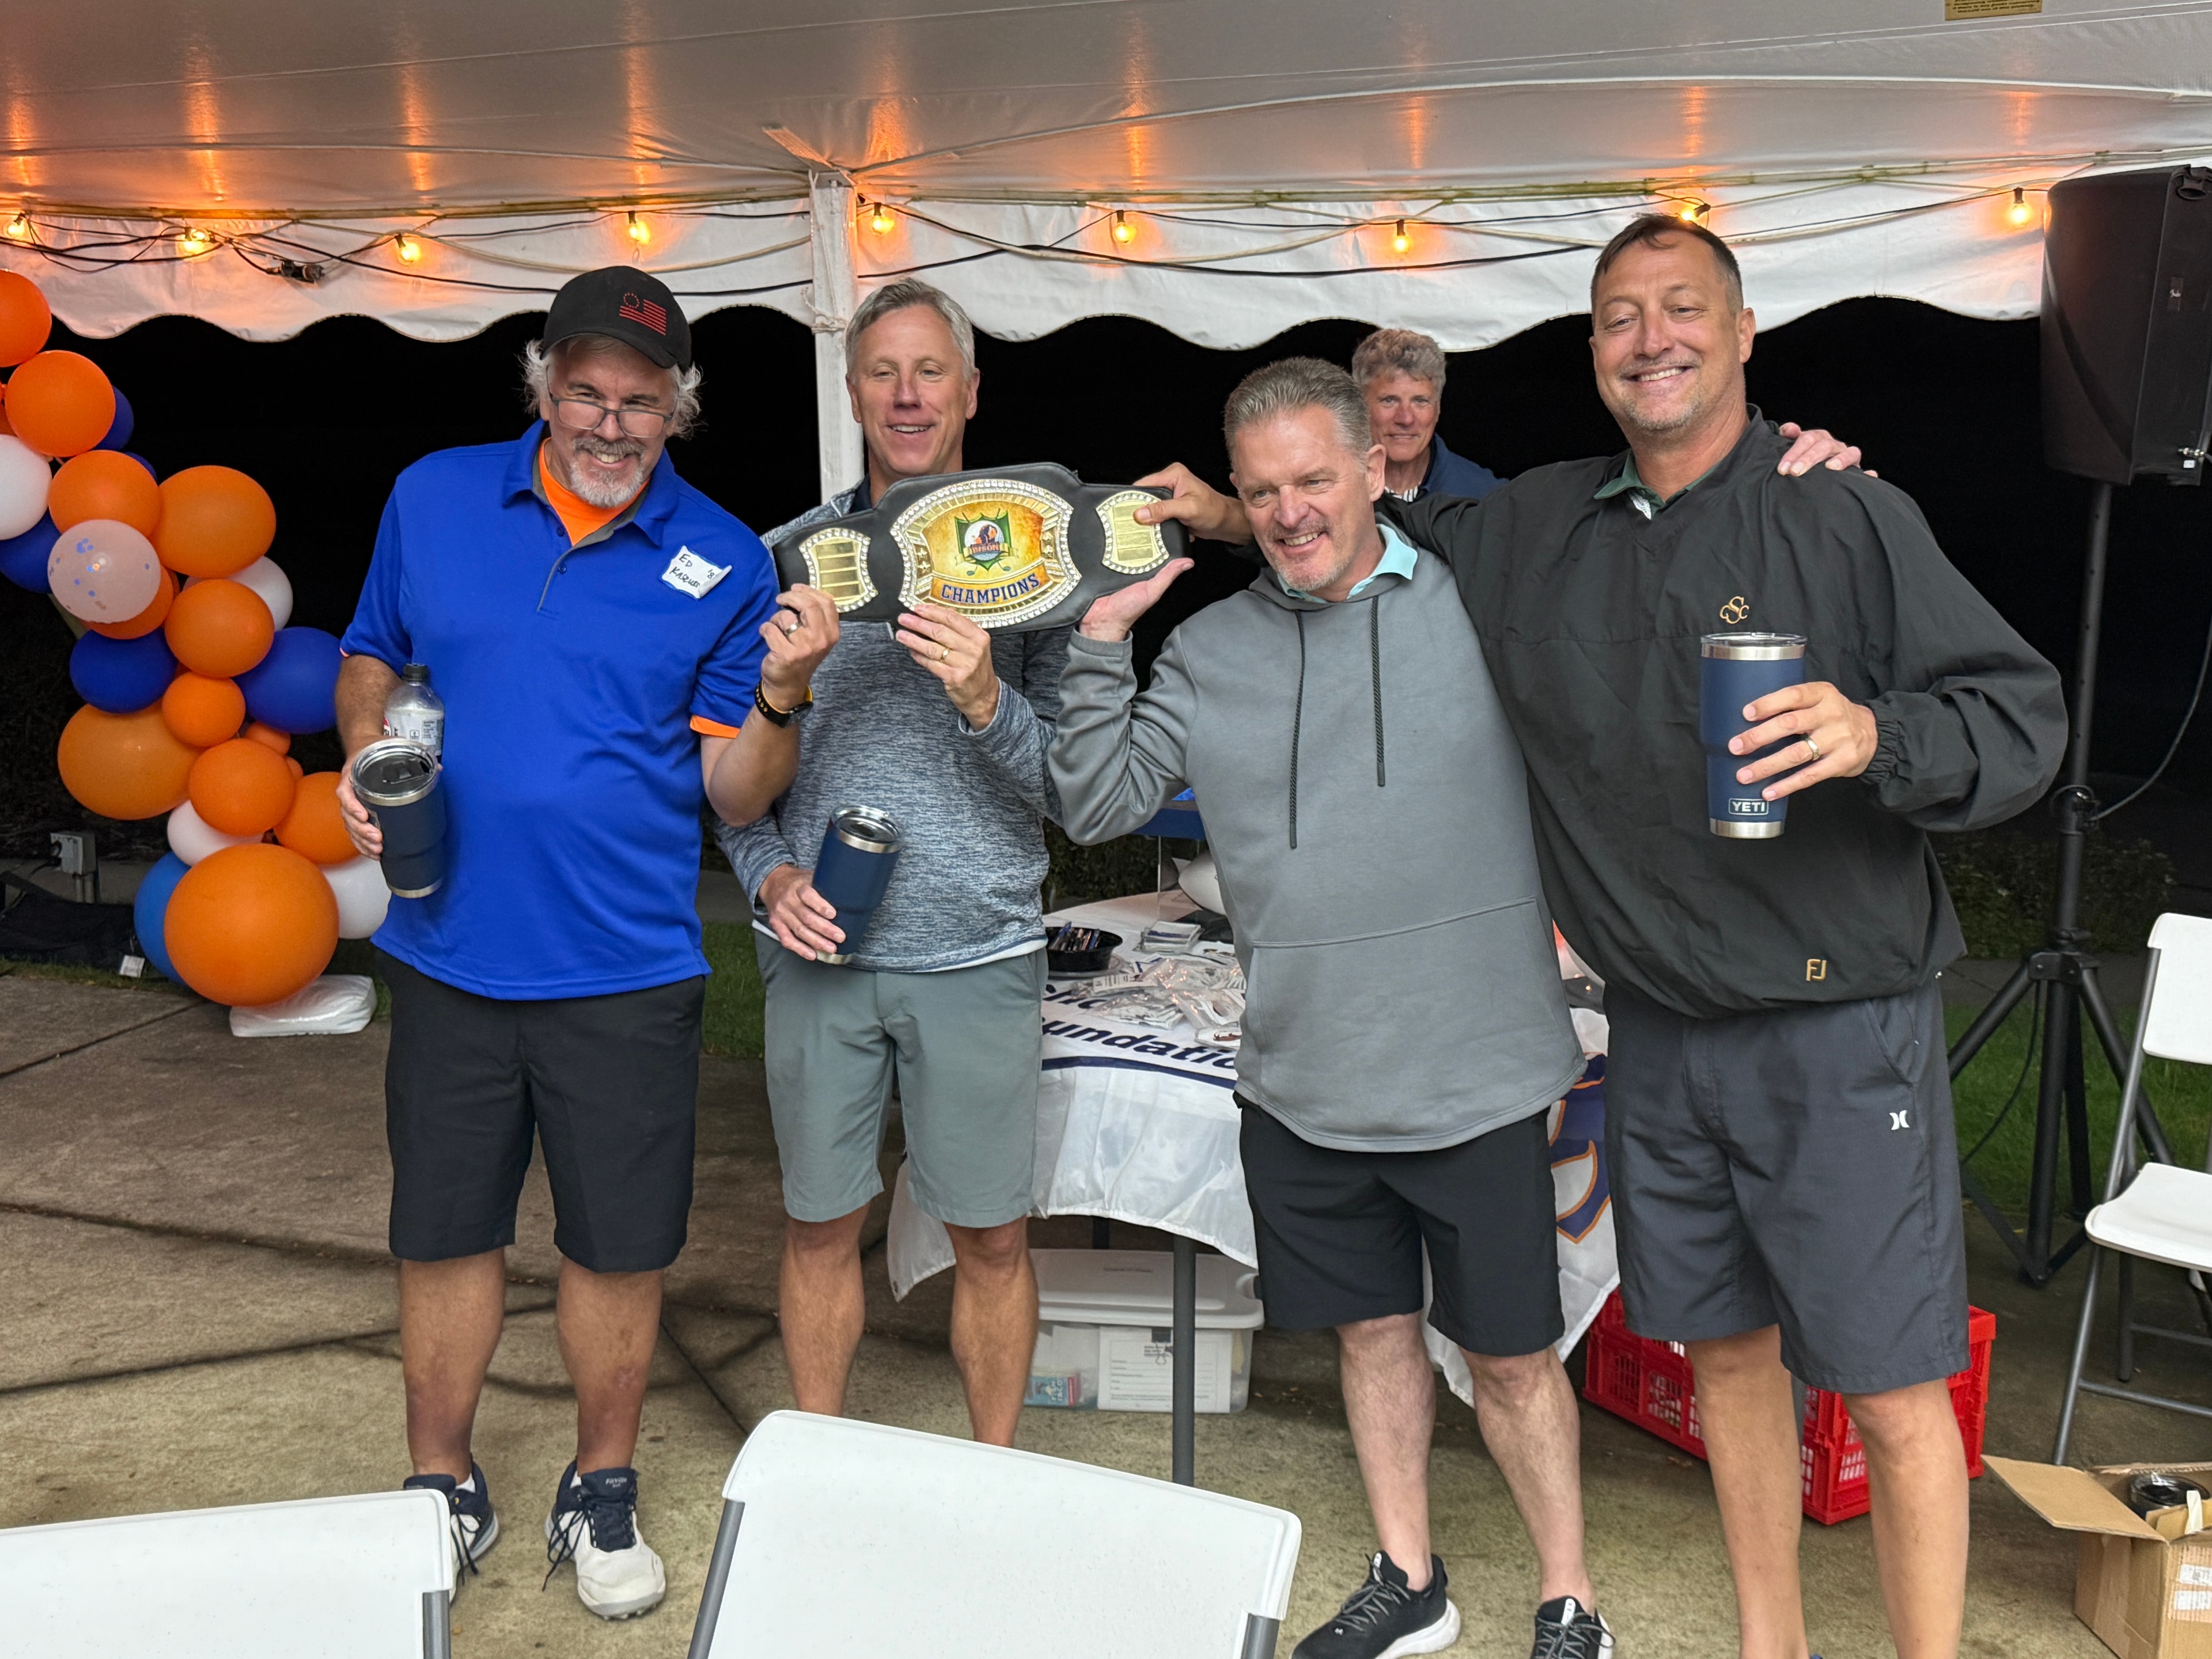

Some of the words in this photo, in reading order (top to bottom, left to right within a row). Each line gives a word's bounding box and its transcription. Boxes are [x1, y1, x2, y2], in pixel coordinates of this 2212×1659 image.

[972, 543, 1000, 554] BISON
[679, 554, 692, 567] ED
[941, 573, 1040, 604] CHAMPIONS
[1732, 801, 1766, 813] YETI
[1805, 959, 1827, 981] FJ
[1042, 1016, 1236, 1070] undatio
